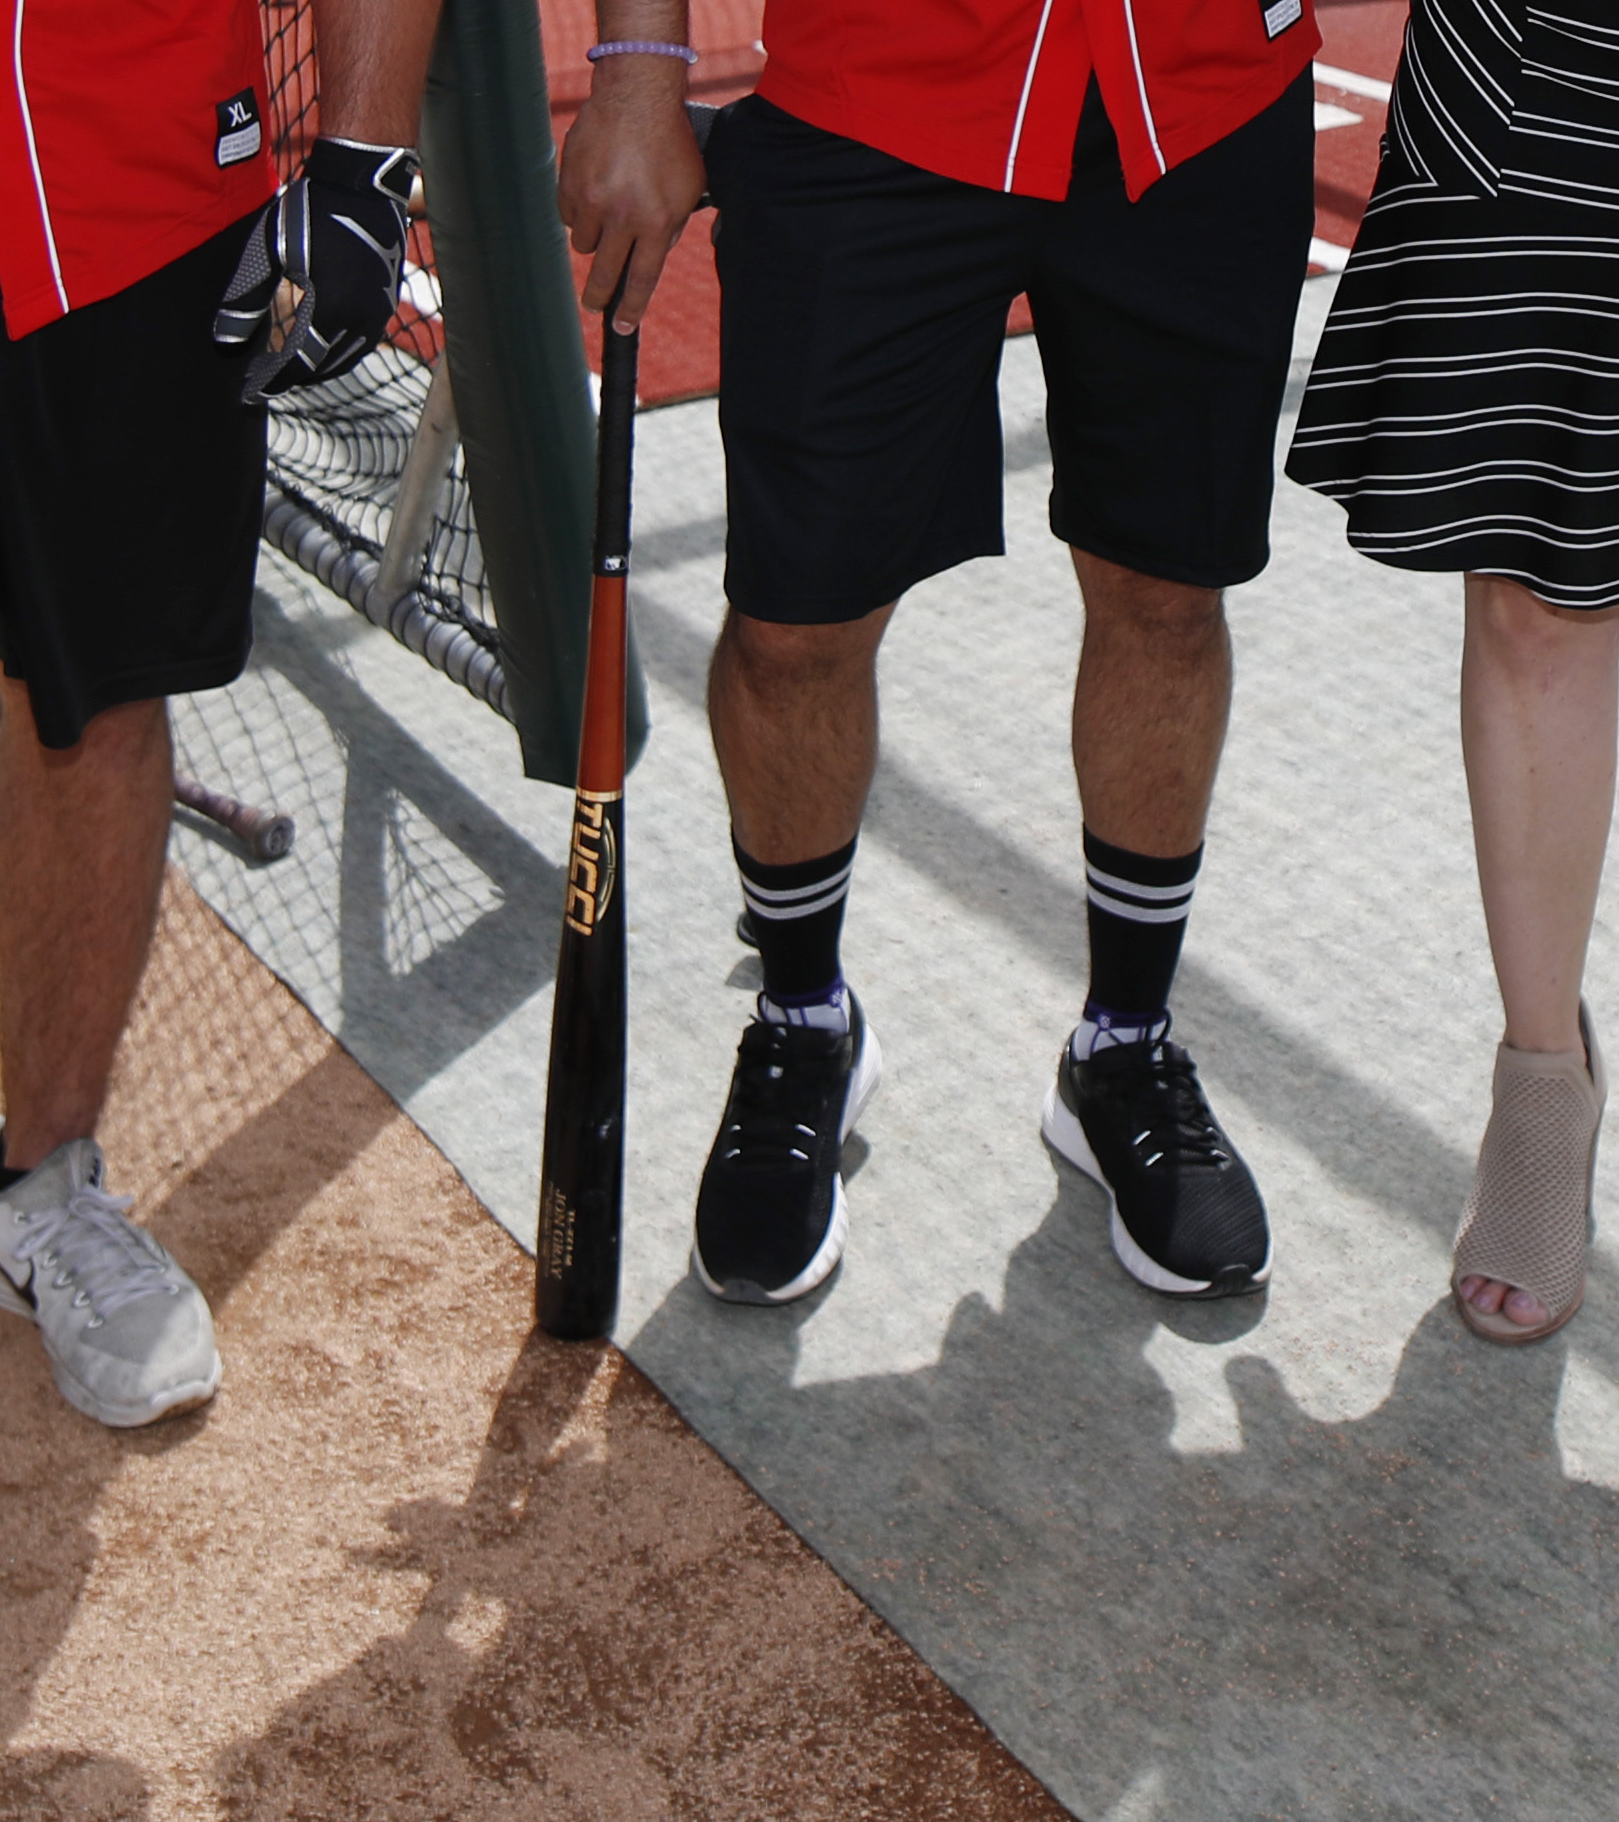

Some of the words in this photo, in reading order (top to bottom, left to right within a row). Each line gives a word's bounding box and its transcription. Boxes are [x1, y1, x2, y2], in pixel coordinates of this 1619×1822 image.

[227, 100, 253, 128] XL
[566, 801, 603, 936] TUCCI
[553, 1187, 568, 1228] JON
[550, 1229, 565, 1281] GRAY
